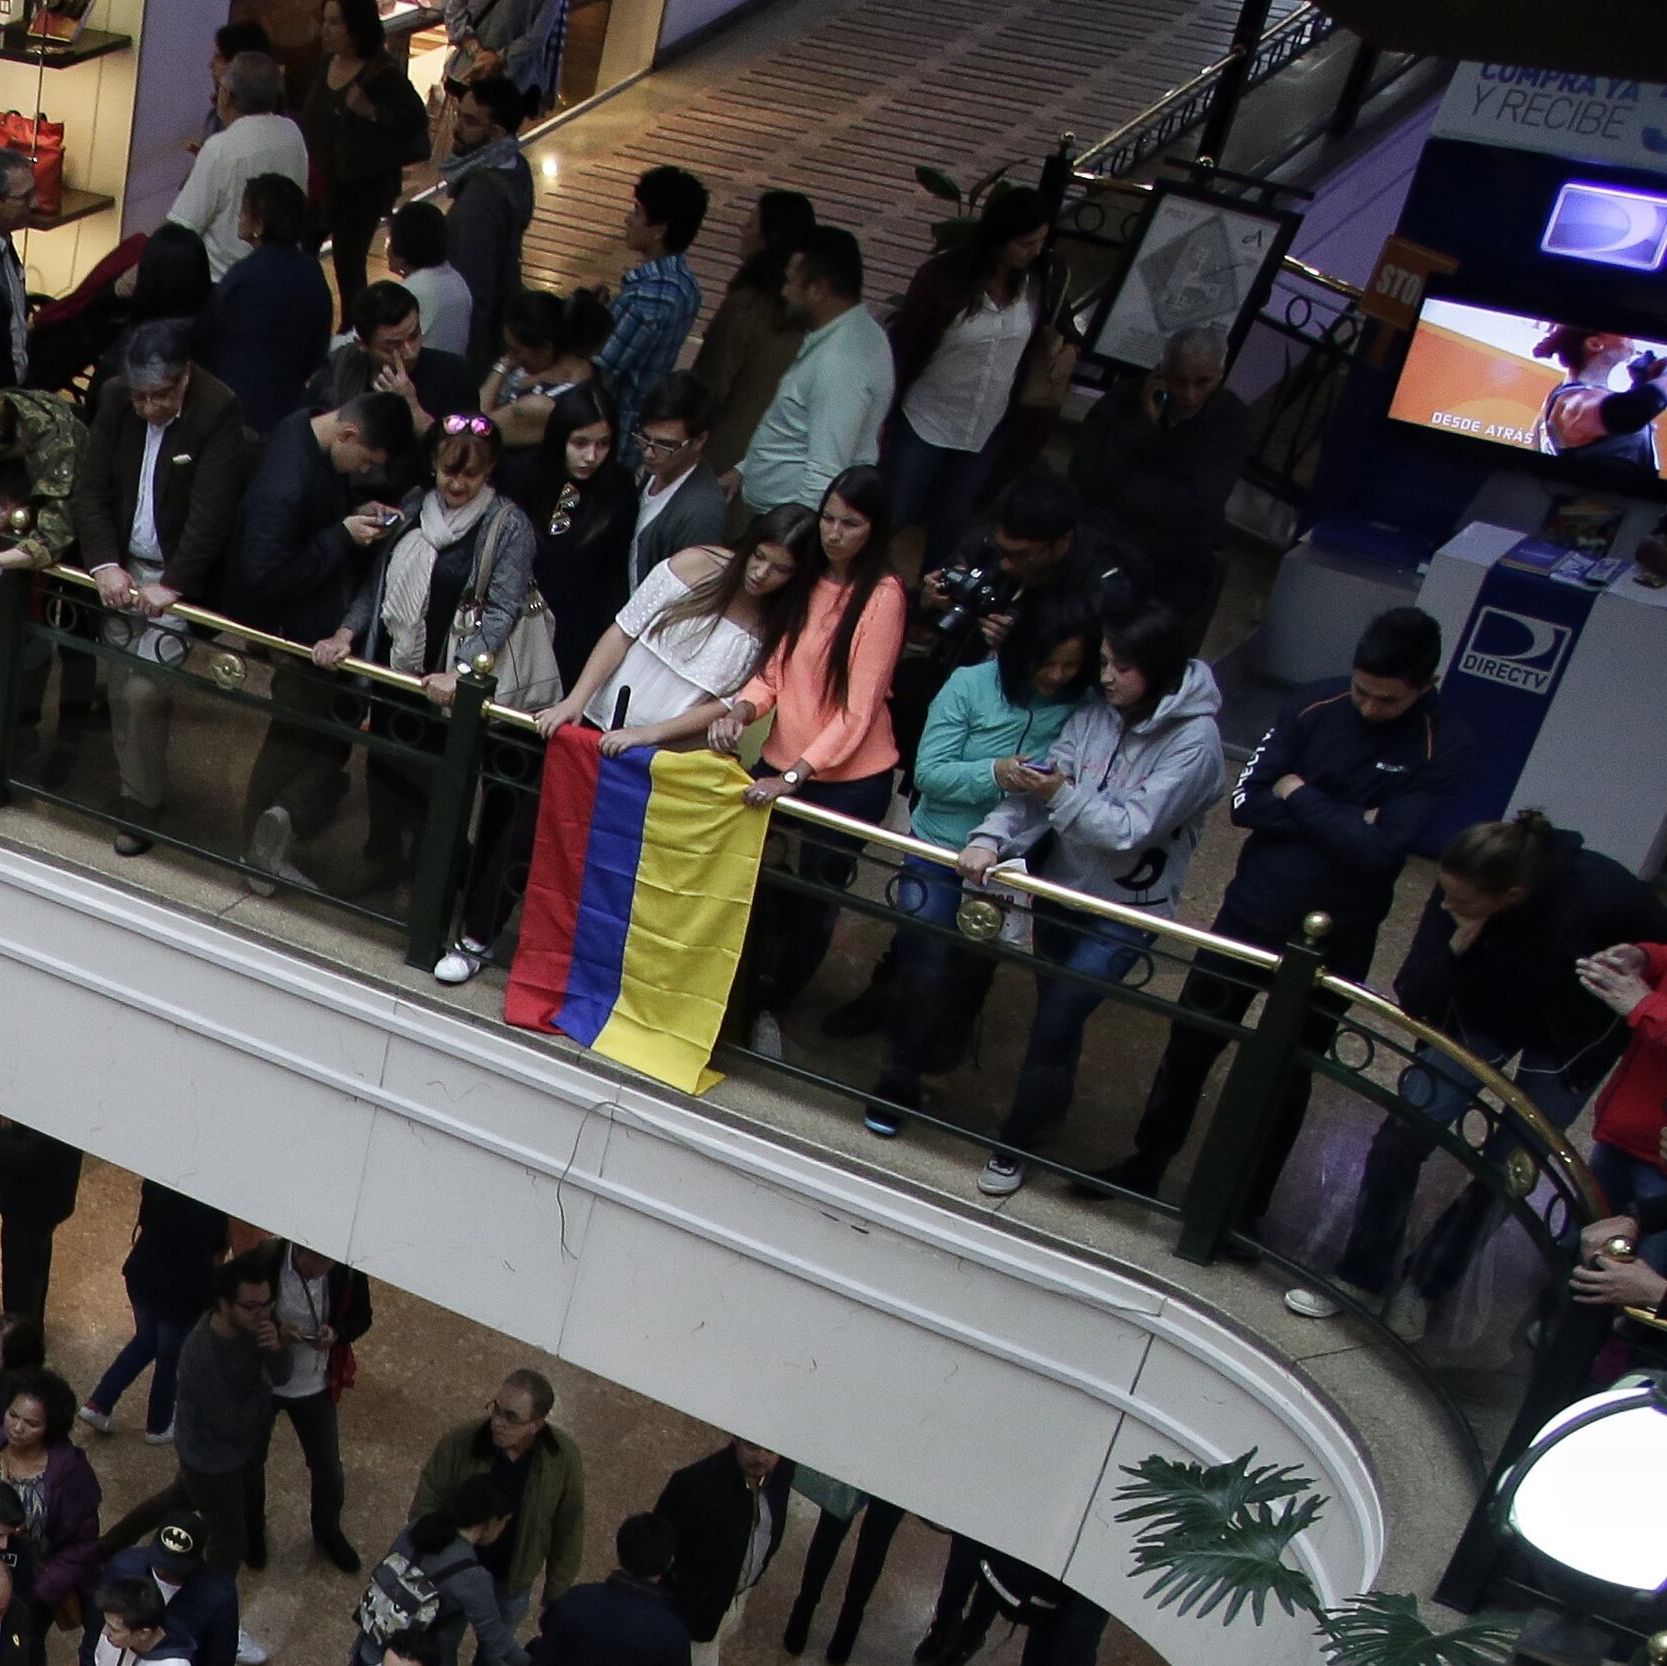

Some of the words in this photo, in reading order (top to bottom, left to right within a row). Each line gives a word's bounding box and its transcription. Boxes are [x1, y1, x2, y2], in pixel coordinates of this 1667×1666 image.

[1472, 83, 1497, 116] Y
[1496, 88, 1634, 139] RECIBE
[1376, 263, 1423, 305] STO
[1431, 411, 1482, 433] DESDE
[1462, 654, 1549, 690] DIRECTV
